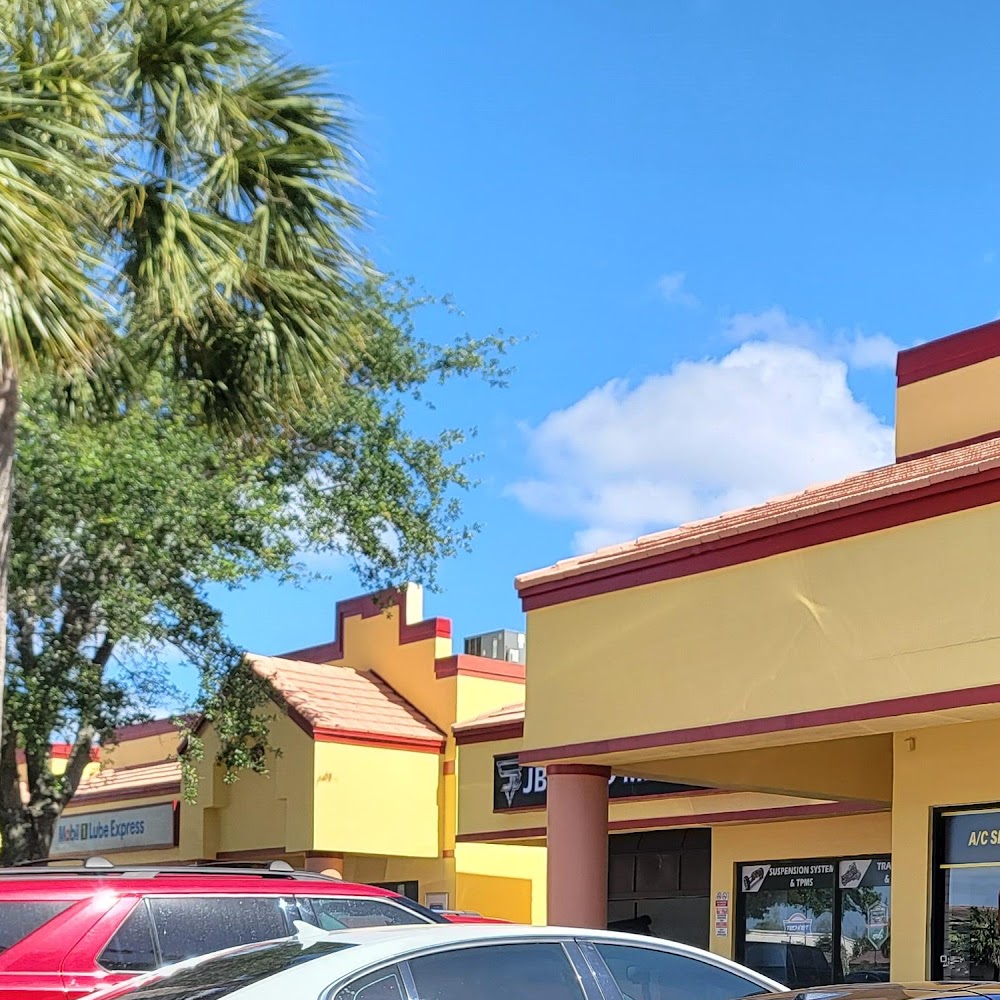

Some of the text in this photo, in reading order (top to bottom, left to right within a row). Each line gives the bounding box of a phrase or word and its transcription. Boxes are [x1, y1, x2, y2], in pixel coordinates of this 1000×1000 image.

[522, 767, 547, 794] JB
[58, 823, 80, 841] Mobil
[89, 821, 109, 839] Lube
[110, 819, 145, 840] Express
[968, 829, 988, 847] A/C
[769, 865, 810, 877] SUSPENSION
[789, 878, 813, 888] & TPMS
